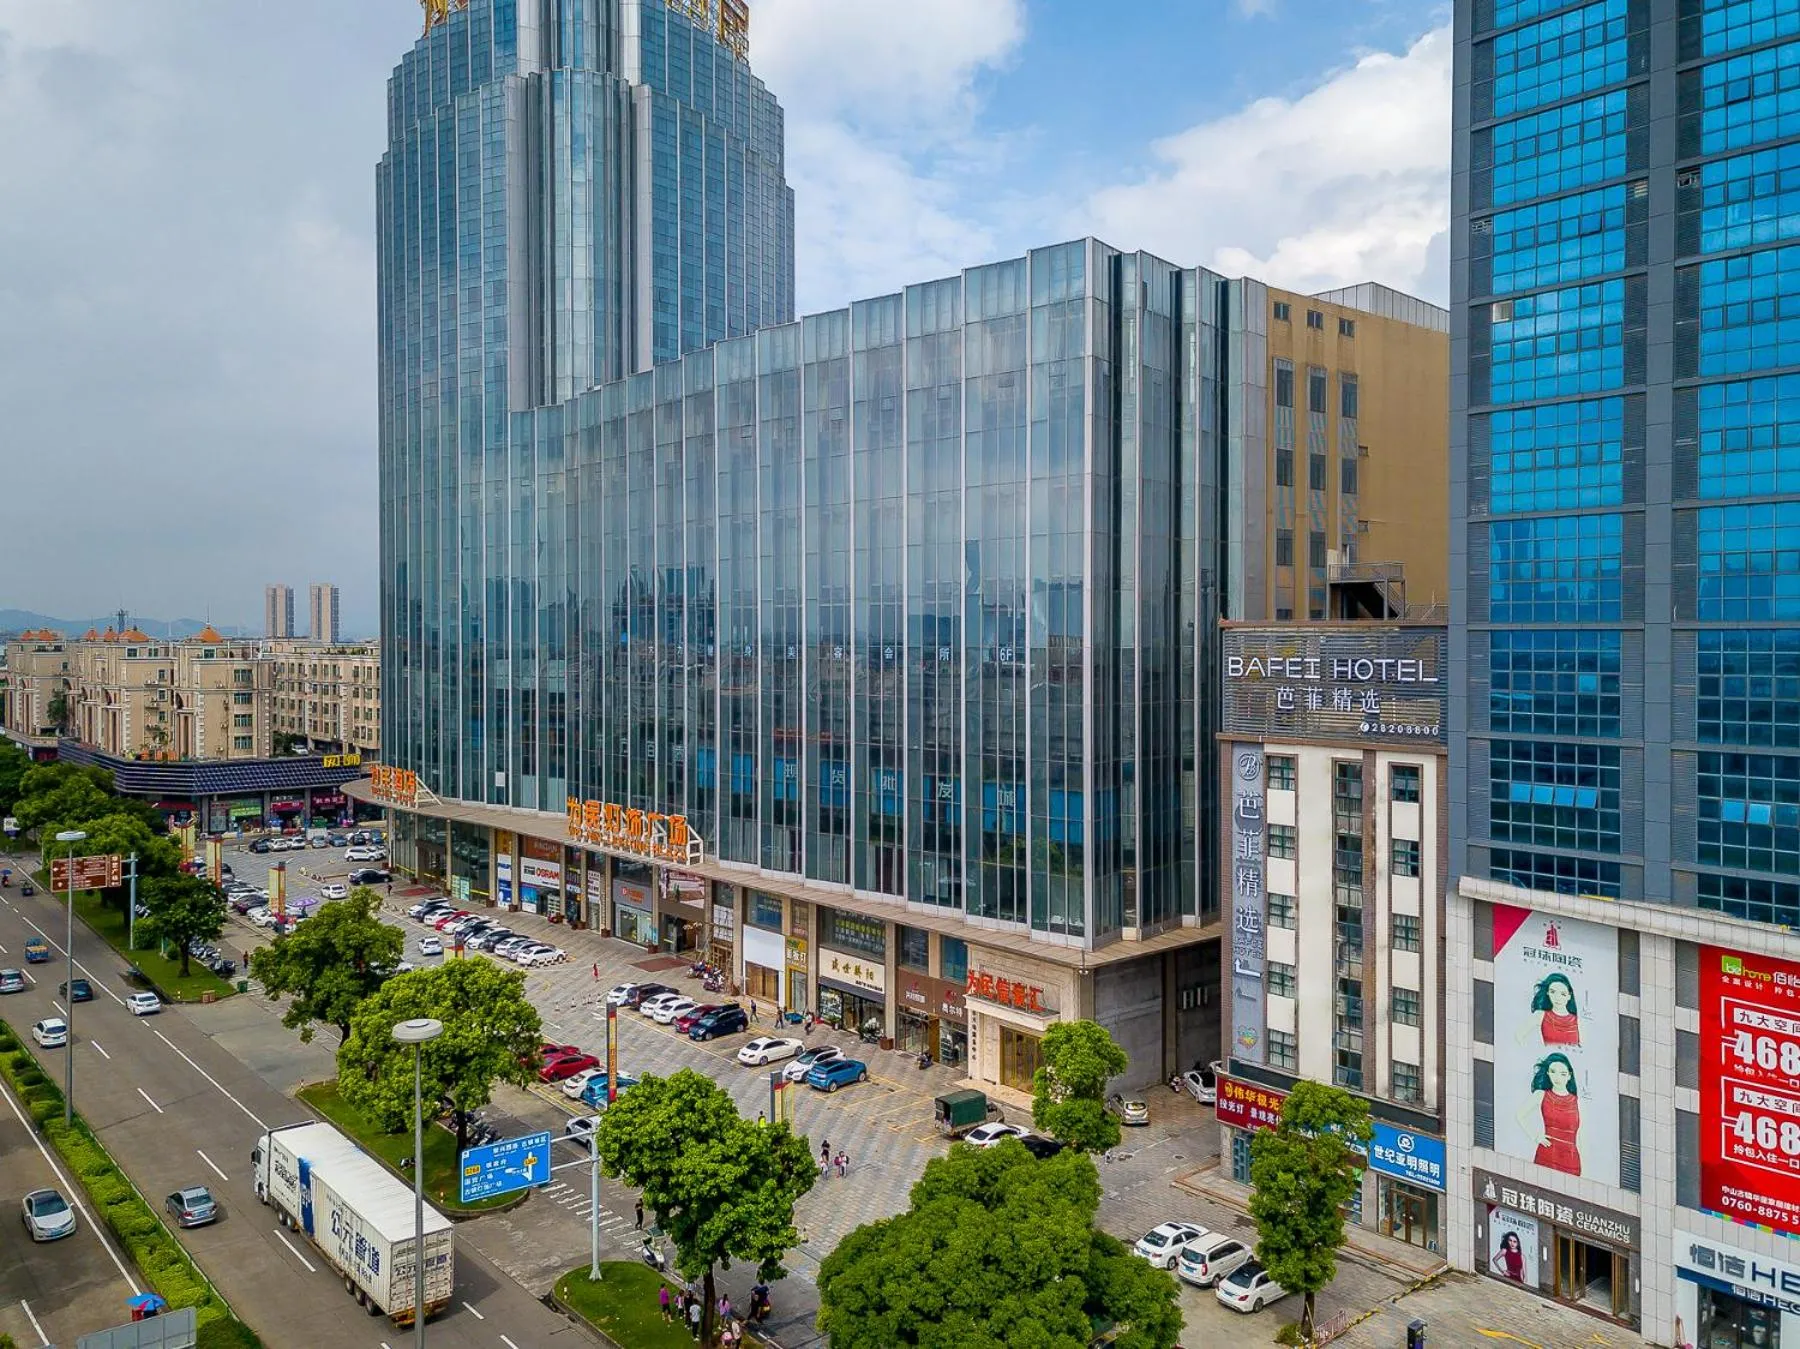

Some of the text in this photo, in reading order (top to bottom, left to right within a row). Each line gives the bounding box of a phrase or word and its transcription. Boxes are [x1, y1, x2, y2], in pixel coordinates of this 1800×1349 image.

[1228, 657, 1439, 683] BAFEI HOTEL
[1276, 687, 1381, 714] 芭菲精选
[1237, 789, 1262, 935] 芭菲精选
[1733, 1111, 1800, 1156] 468
[1374, 1145, 1440, 1178] 世纪亚明照明
[1501, 1186, 1574, 1226] 冠珠陶瓷
[1721, 1195, 1789, 1222] 0760-8875
[1576, 1211, 1631, 1234] GUANZHU
[1576, 1220, 1631, 1244] CERAMICS
